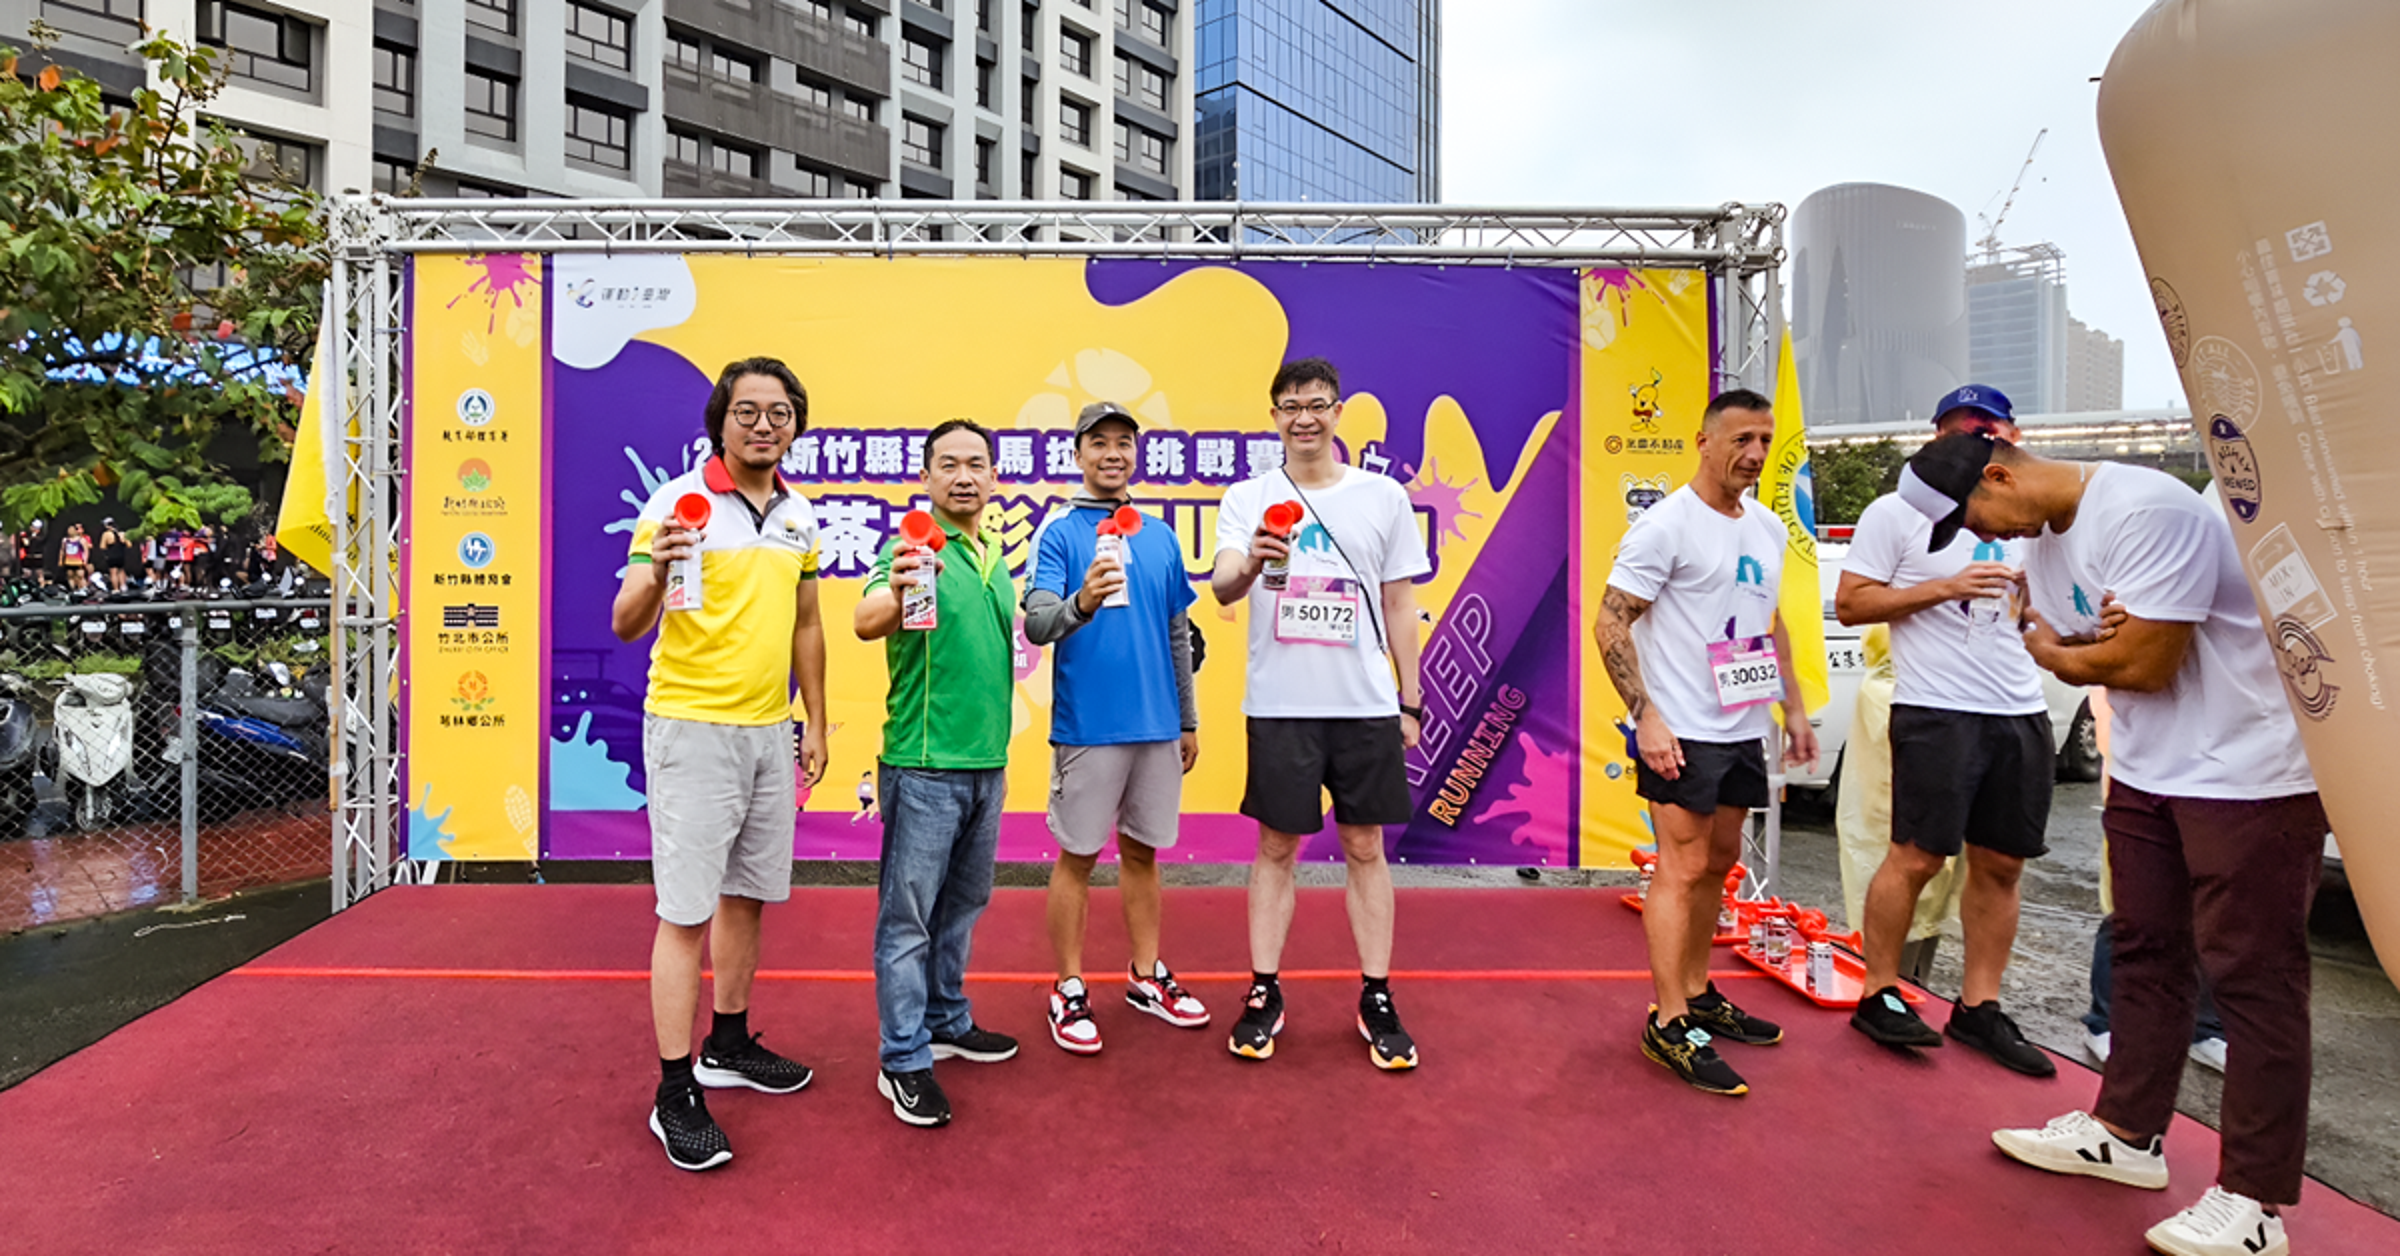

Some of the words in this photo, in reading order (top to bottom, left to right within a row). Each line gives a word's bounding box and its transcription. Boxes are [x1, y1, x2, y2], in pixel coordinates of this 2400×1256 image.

[1299, 605, 1353, 622] 50172
[1732, 663, 1777, 685] 30032
[1428, 683, 1527, 826] RUNNING
